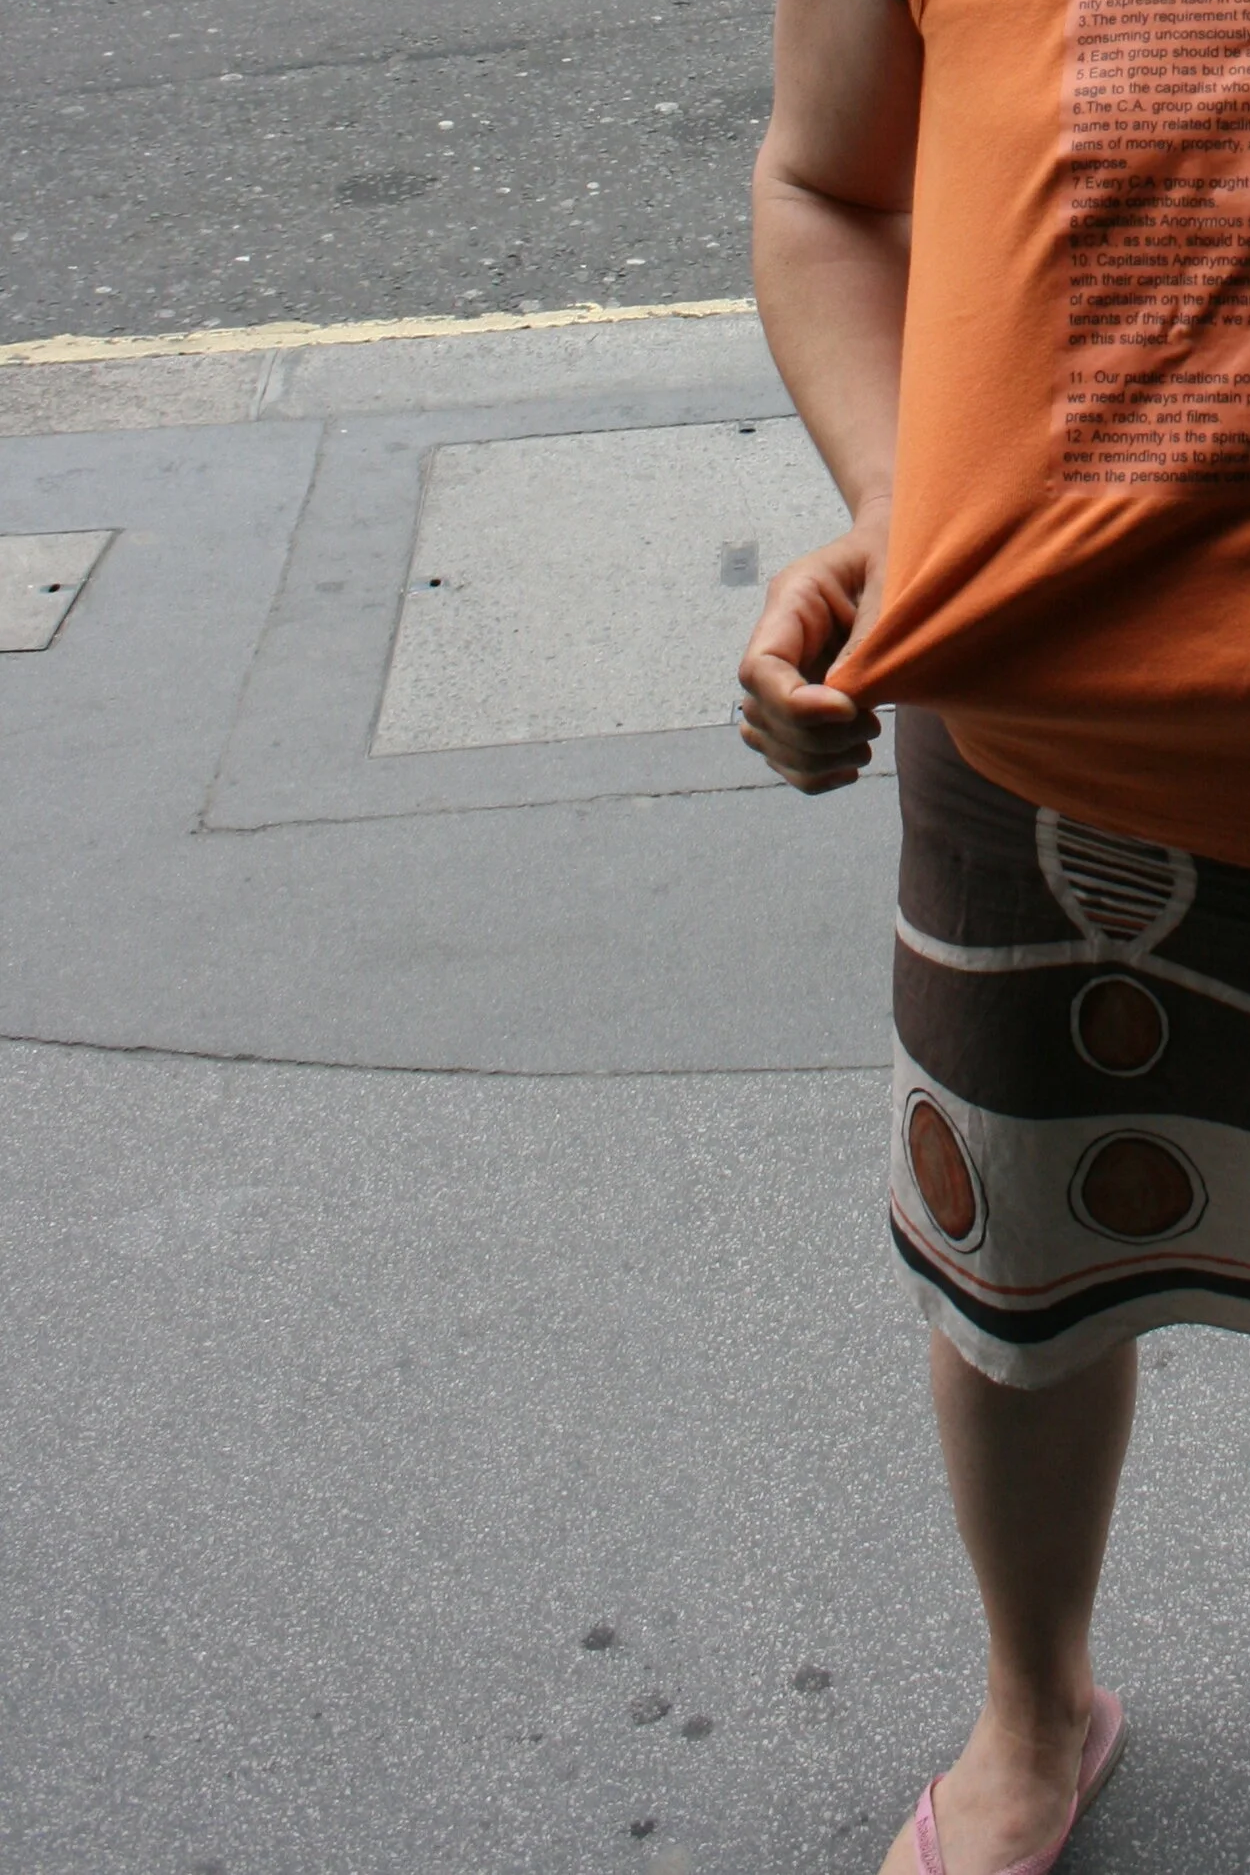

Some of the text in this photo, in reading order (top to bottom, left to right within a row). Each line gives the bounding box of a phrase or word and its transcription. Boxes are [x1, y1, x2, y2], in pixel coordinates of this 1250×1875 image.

[1121, 11, 1148, 25] only
[1154, 10, 1237, 25] requirement
[1078, 30, 1151, 44] consuming
[1128, 48, 1168, 62] group
[1172, 45, 1219, 57] should
[1224, 45, 1241, 56] be
[1127, 66, 1167, 79] group
[1172, 63, 1197, 75] has
[1202, 63, 1224, 74] but
[1074, 85, 1106, 98] sage
[1112, 83, 1124, 93] to
[1129, 81, 1150, 93] the
[1155, 81, 1216, 95] capitalist
[1221, 81, 1250, 92] who
[1152, 102, 1192, 114] group
[1197, 99, 1237, 114] ought
[1073, 121, 1110, 132] name
[1115, 119, 1128, 130] to
[1132, 120, 1158, 132] any
[1162, 118, 1211, 129] related
[1071, 139, 1103, 150] lems
[1108, 137, 1121, 149] of
[1209, 176, 1248, 191] ought
[1160, 215, 1243, 229] Anonymous
[1097, 254, 1168, 269] Capitalists
[1069, 273, 1097, 285] with
[1102, 273, 1132, 285] their
[1137, 273, 1199, 288] capitalist
[1070, 293, 1082, 305] of
[1161, 295, 1179, 304] on
[1091, 332, 1115, 344] this
[1094, 372, 1119, 383] Our
[1170, 372, 1228, 384] relations
[1183, 391, 1241, 403] maintain
[1157, 411, 1182, 422] and
[1091, 430, 1207, 445] Anonymity the
[1098, 450, 1166, 464] reminding
[1172, 452, 1188, 461] us
[1063, 469, 1100, 481] when
